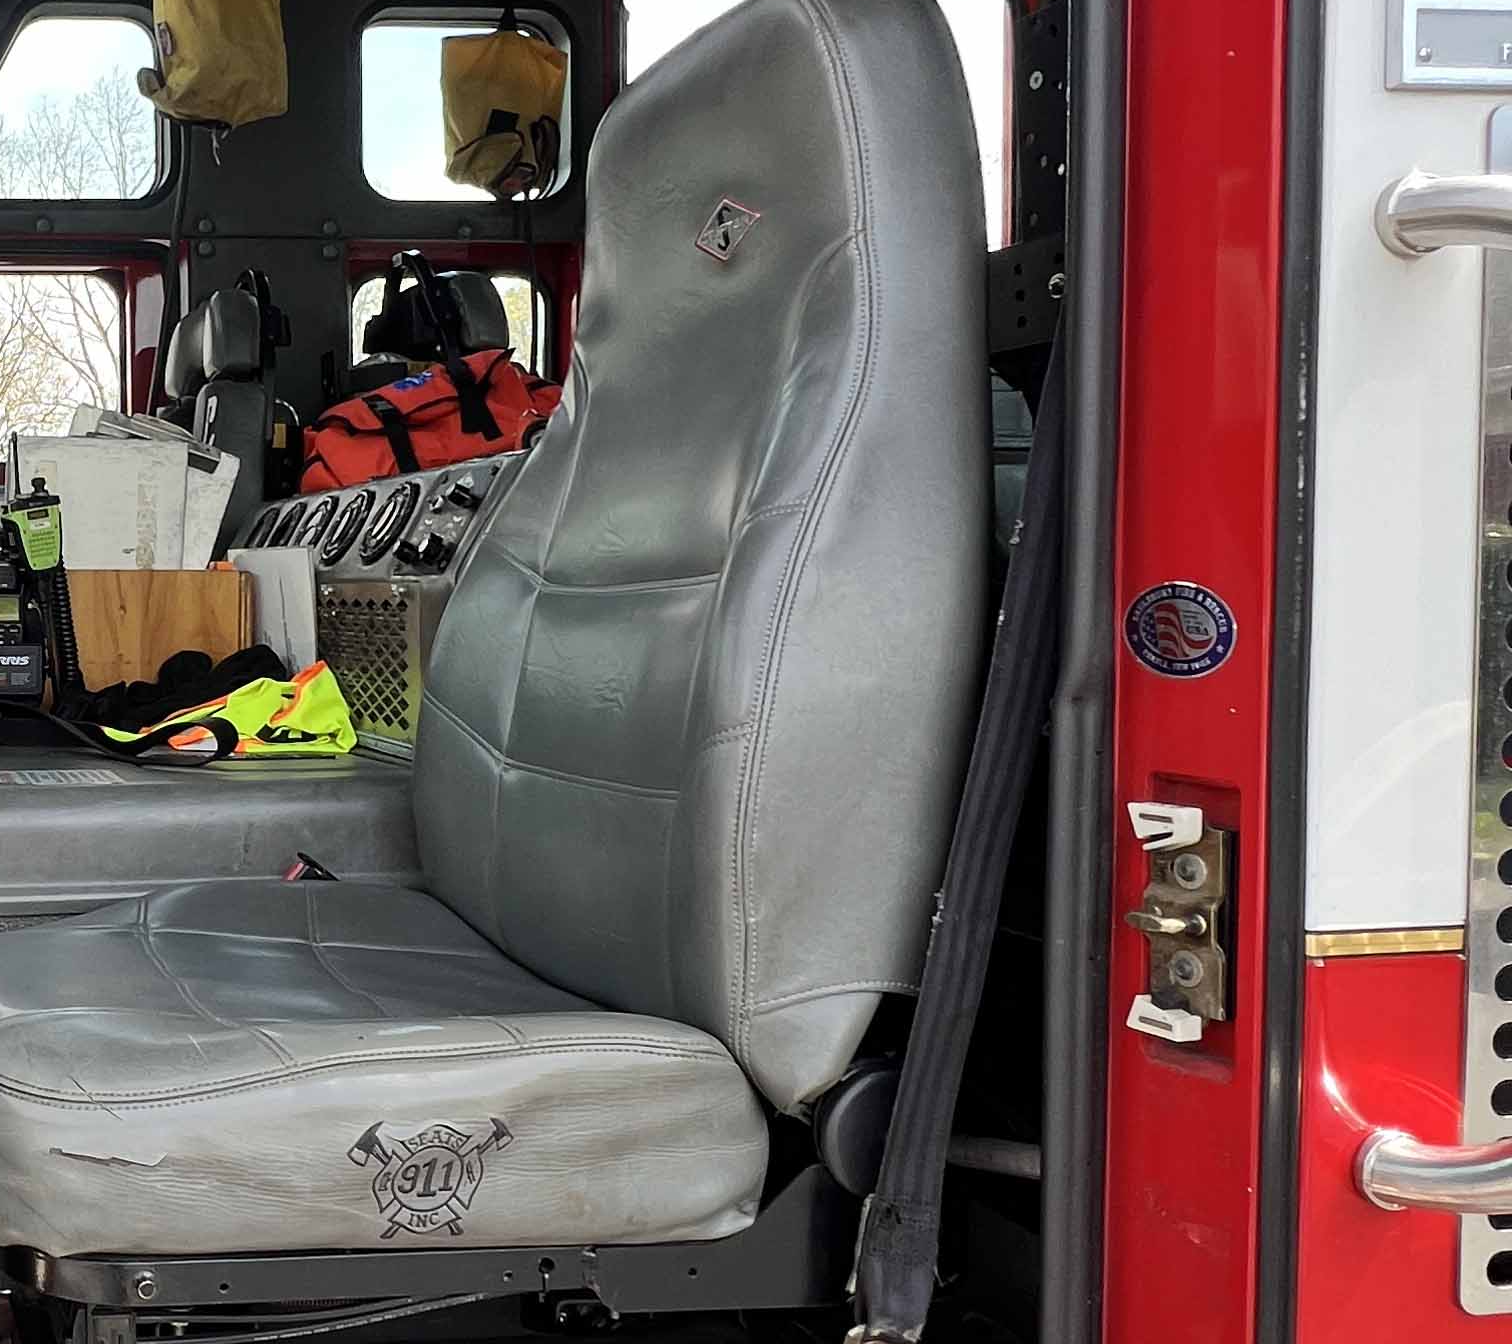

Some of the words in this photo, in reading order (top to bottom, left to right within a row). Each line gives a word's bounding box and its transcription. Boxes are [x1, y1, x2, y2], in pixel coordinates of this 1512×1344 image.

[408, 1129, 465, 1151] SEATS
[397, 1157, 453, 1198] 911
[407, 1211, 441, 1229] INC
